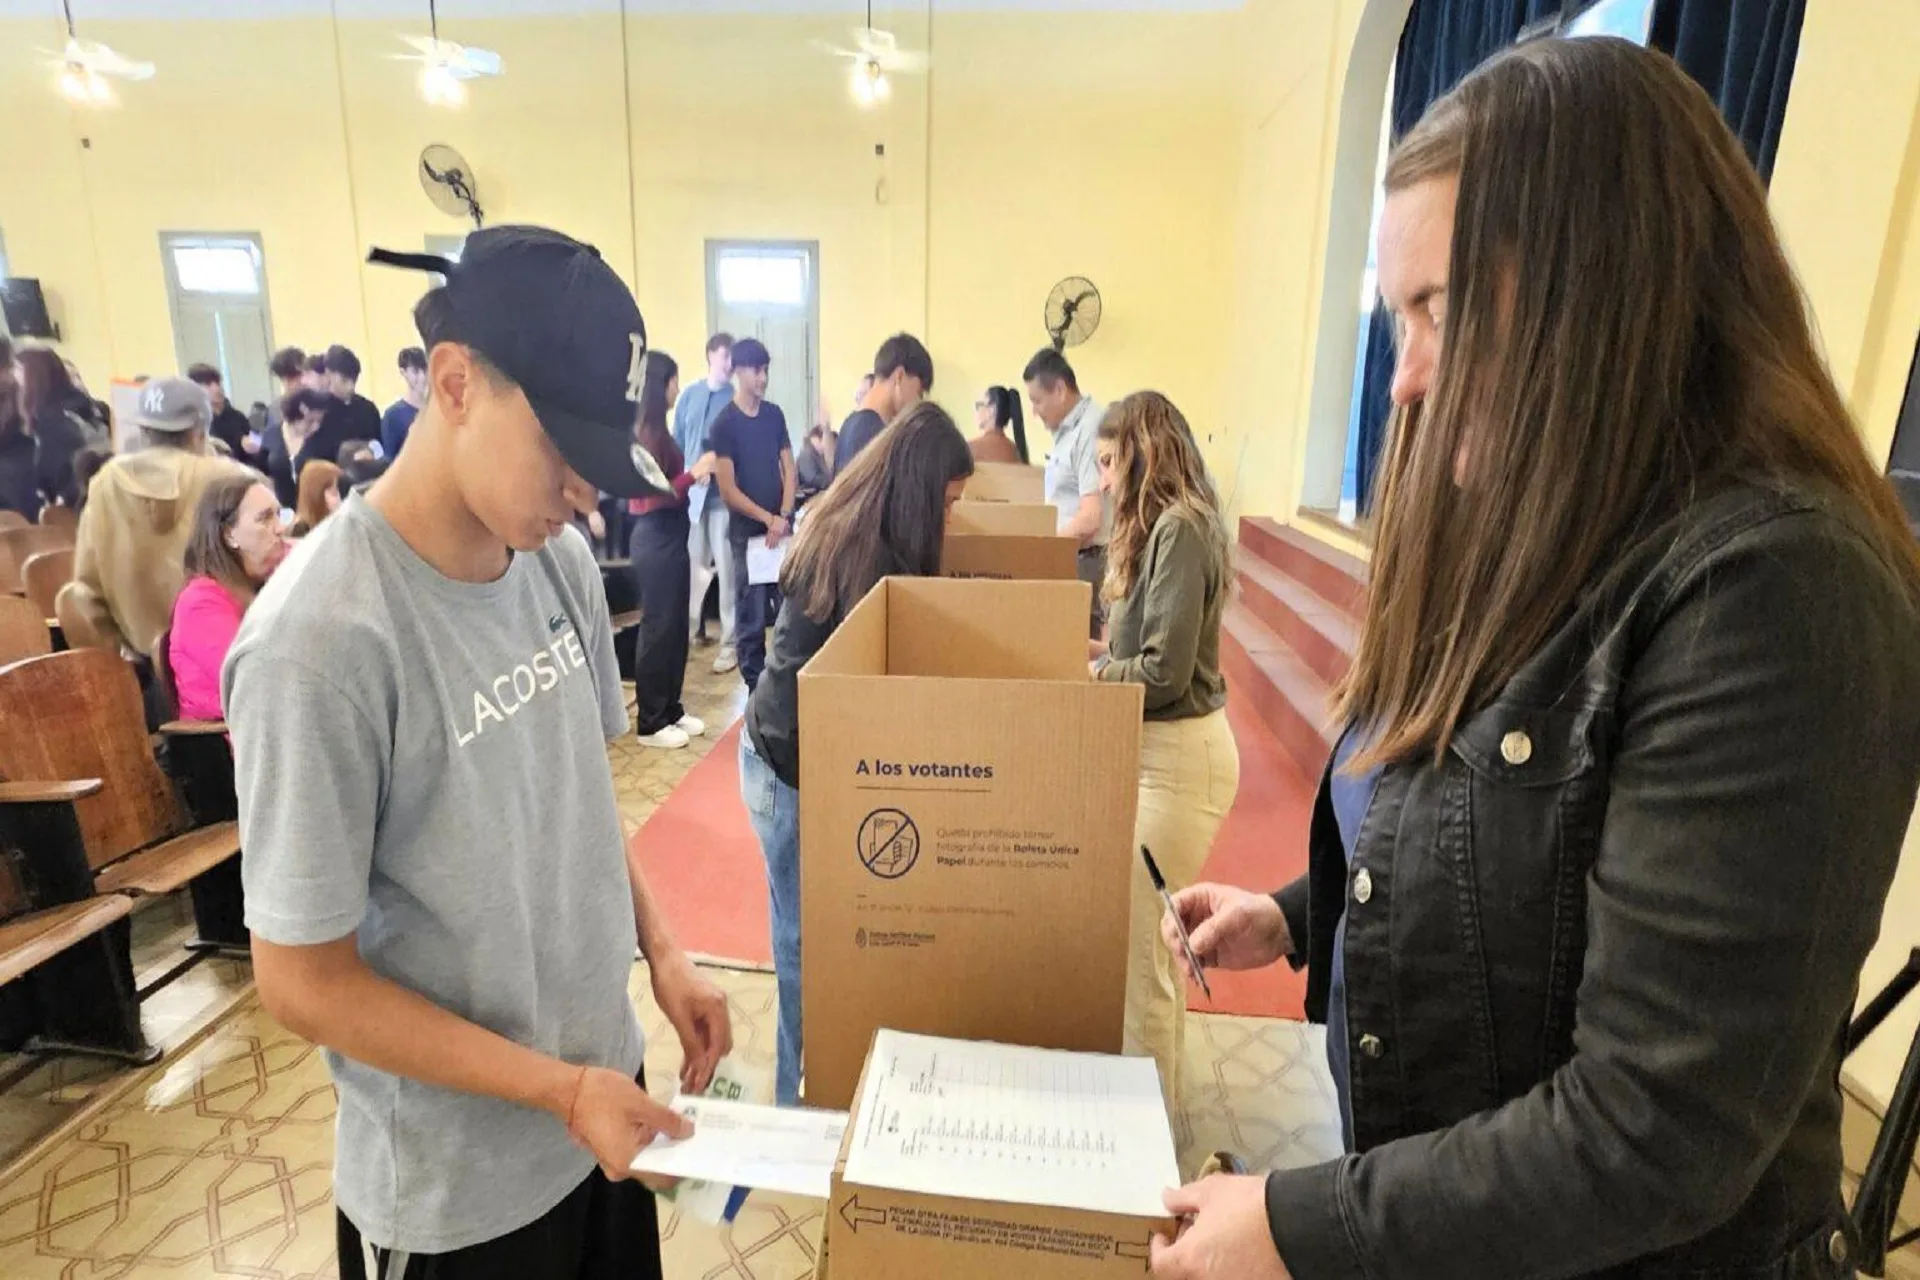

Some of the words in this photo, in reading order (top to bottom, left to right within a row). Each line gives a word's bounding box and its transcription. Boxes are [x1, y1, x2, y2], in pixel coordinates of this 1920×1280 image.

[453, 628, 585, 747] LACOSTE
[855, 759, 870, 775] A
[875, 759, 903, 776] los
[908, 762, 994, 778] votantes
[1014, 844, 1046, 854] Boleta
[937, 856, 966, 867] Papel
